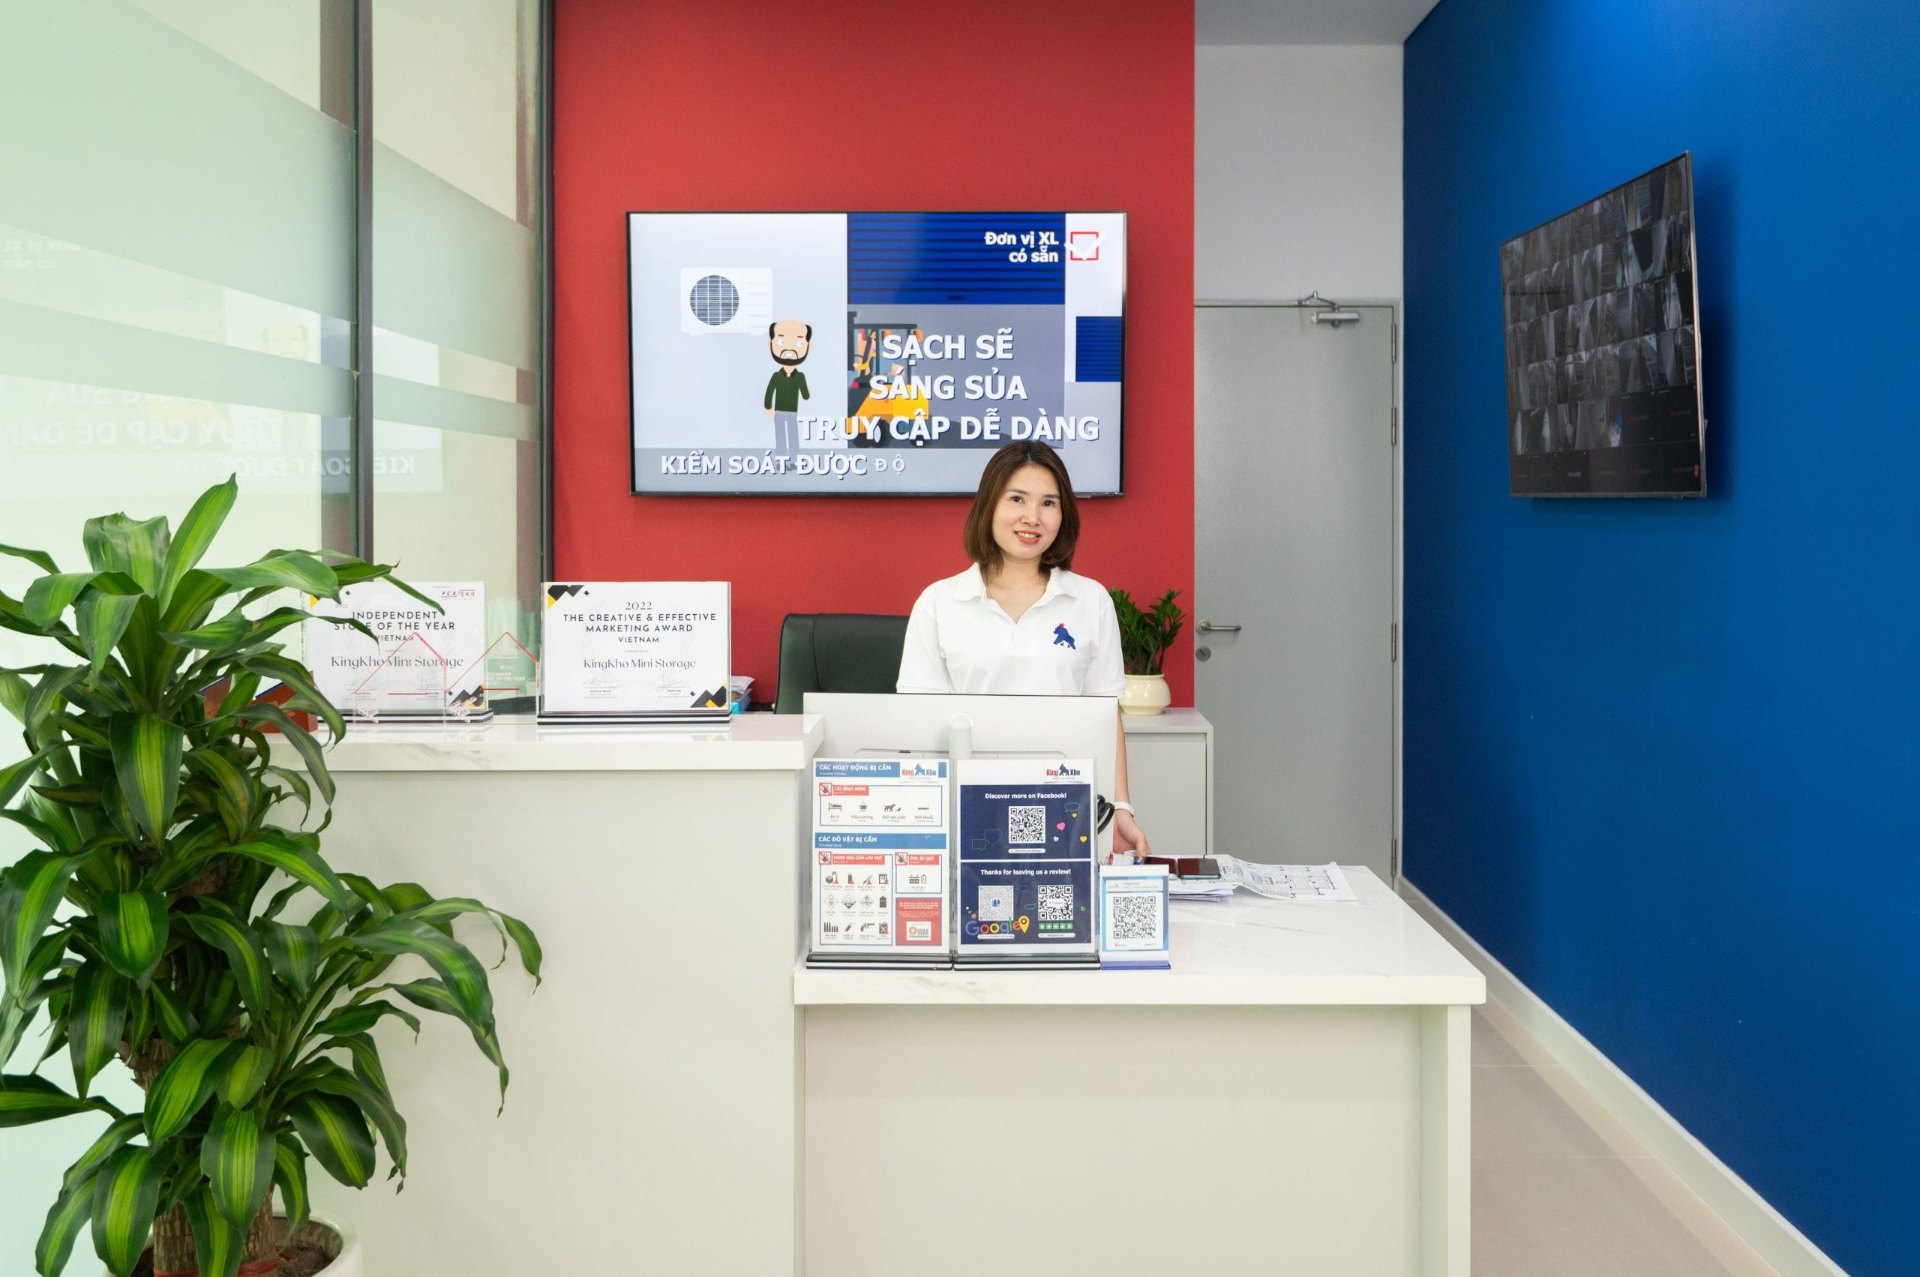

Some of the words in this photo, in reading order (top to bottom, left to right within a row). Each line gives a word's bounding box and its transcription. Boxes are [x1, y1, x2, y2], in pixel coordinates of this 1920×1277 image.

[984, 231, 1017, 246] Đơn
[1020, 231, 1035, 248] vị
[1038, 231, 1059, 245] XL
[1008, 248, 1028, 262] có
[1031, 245, 1058, 262] sẵn
[882, 334, 966, 366] SẠCH
[976, 328, 1014, 361] SẼ
[869, 366, 956, 400] SÁNG
[964, 366, 1028, 401] SỦA
[798, 415, 882, 441] TRUY
[889, 408, 950, 446] CẬP
[960, 408, 1000, 440] DỄ
[1010, 408, 1100, 441] DÀNG
[661, 450, 722, 475] KIỂM
[728, 450, 790, 475] SOÁT
[795, 450, 868, 480] ĐƯỢC
[625, 601, 653, 611] 2022
[352, 611, 437, 620] INDEPENDENT
[563, 614, 584, 622] THE
[589, 614, 642, 622] CREATIVE
[646, 614, 653, 622] &
[658, 613, 717, 622] EFFECTIVE
[334, 621, 372, 630] STOE
[377, 621, 393, 631] OF
[398, 621, 420, 631] THE
[425, 621, 456, 631] YEAR
[586, 624, 650, 632] MARKETING
[655, 624, 693, 632] AWARD
[331, 655, 386, 669] KingKho
[387, 656, 412, 667] Mini
[583, 657, 629, 671] KingKho
[631, 657, 653, 669] Mini
[655, 658, 697, 671] Storage
[965, 917, 1021, 935] Google
